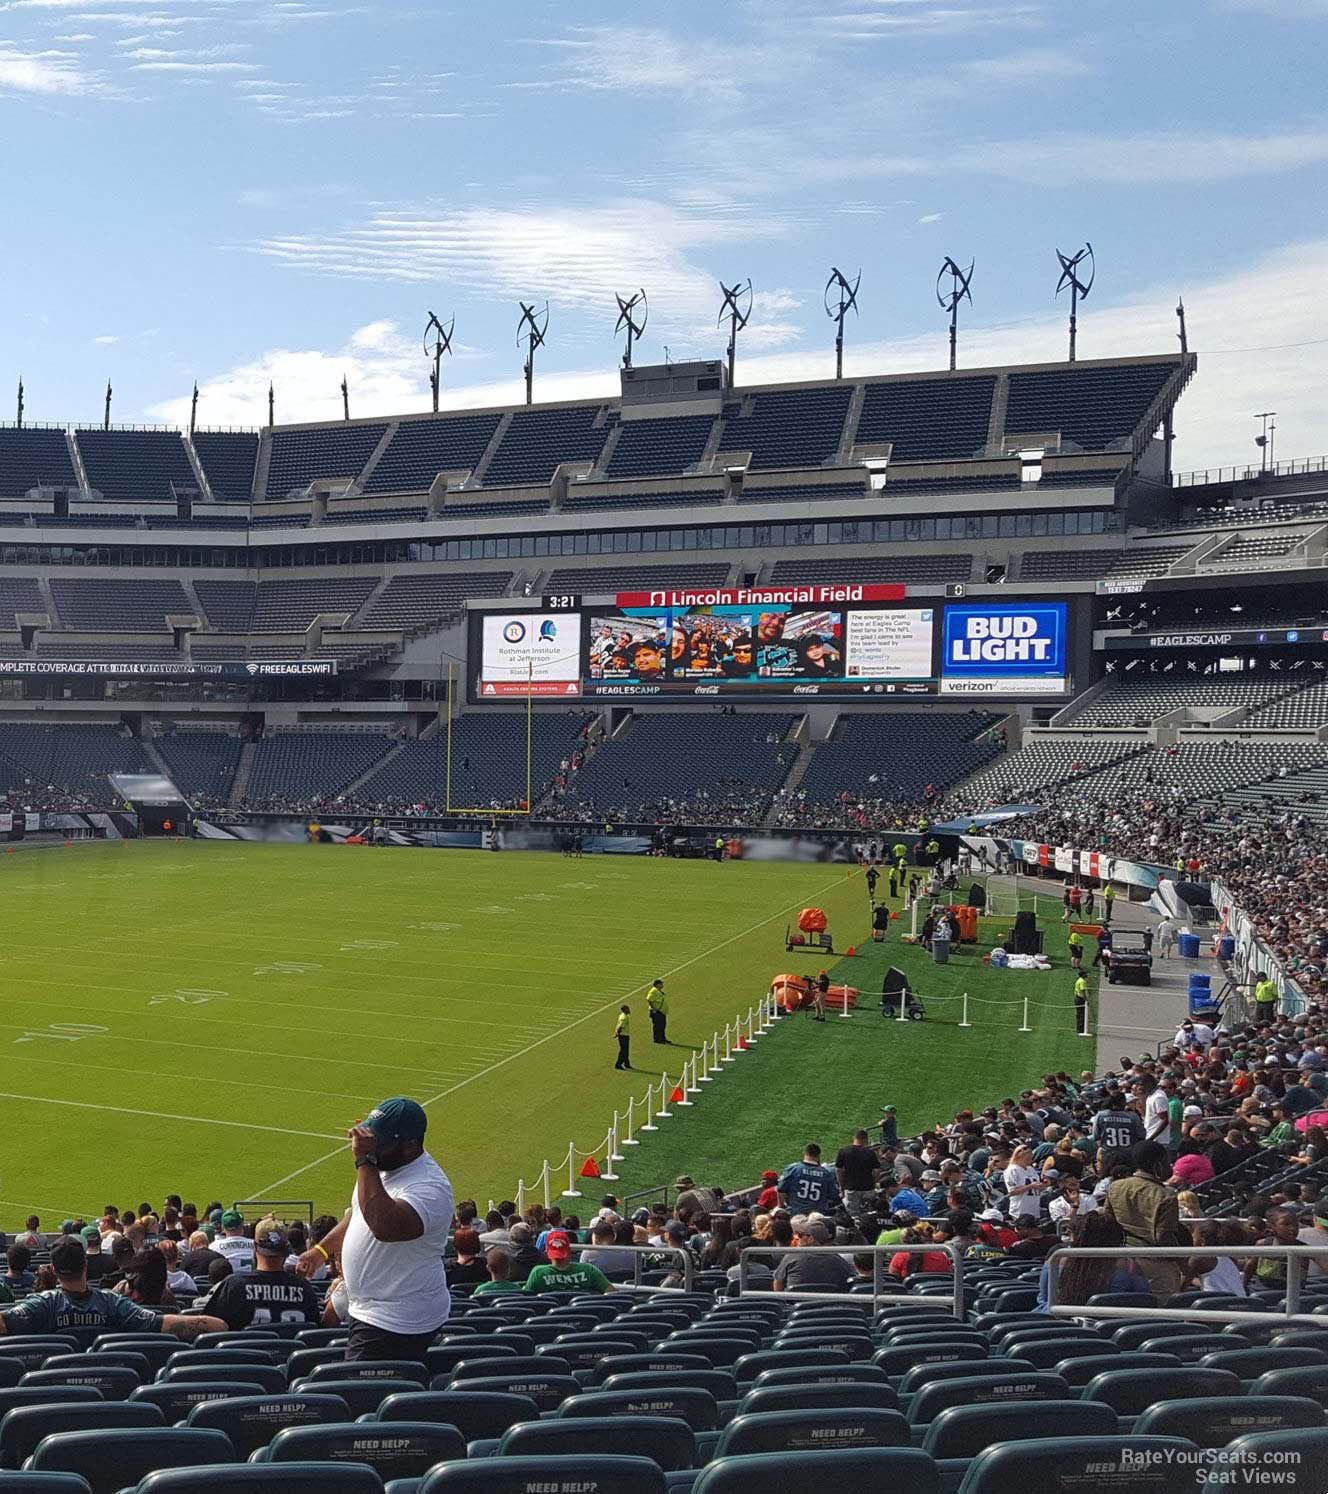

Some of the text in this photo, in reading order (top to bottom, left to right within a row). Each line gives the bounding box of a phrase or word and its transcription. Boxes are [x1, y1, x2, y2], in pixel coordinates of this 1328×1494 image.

[955, 585, 962, 595] 0
[672, 586, 863, 606] Lincoln Financial Field
[550, 596, 575, 607] 3:21
[967, 617, 1038, 638] BUD
[1150, 635, 1231, 647] #EAGLESCAMP
[532, 647, 561, 655] Institute
[37, 663, 84, 673] COVERAGE
[260, 664, 330, 674] FREEEAGLESWIFI
[596, 687, 660, 695] #EAGLESCAMP
[949, 681, 993, 691] verizon
[1105, 1127, 1131, 1147] 36
[797, 1179, 822, 1201] 35
[543, 1272, 588, 1286] WENTZ
[246, 1284, 304, 1303] SPROLES
[260, 1405, 280, 1413] NEED
[812, 1429, 837, 1438] NEED
[354, 1439, 410, 1449] NEED HELP?
[1085, 1463, 1116, 1473] NEED
[527, 1482, 598, 1494] NEED HELP?
